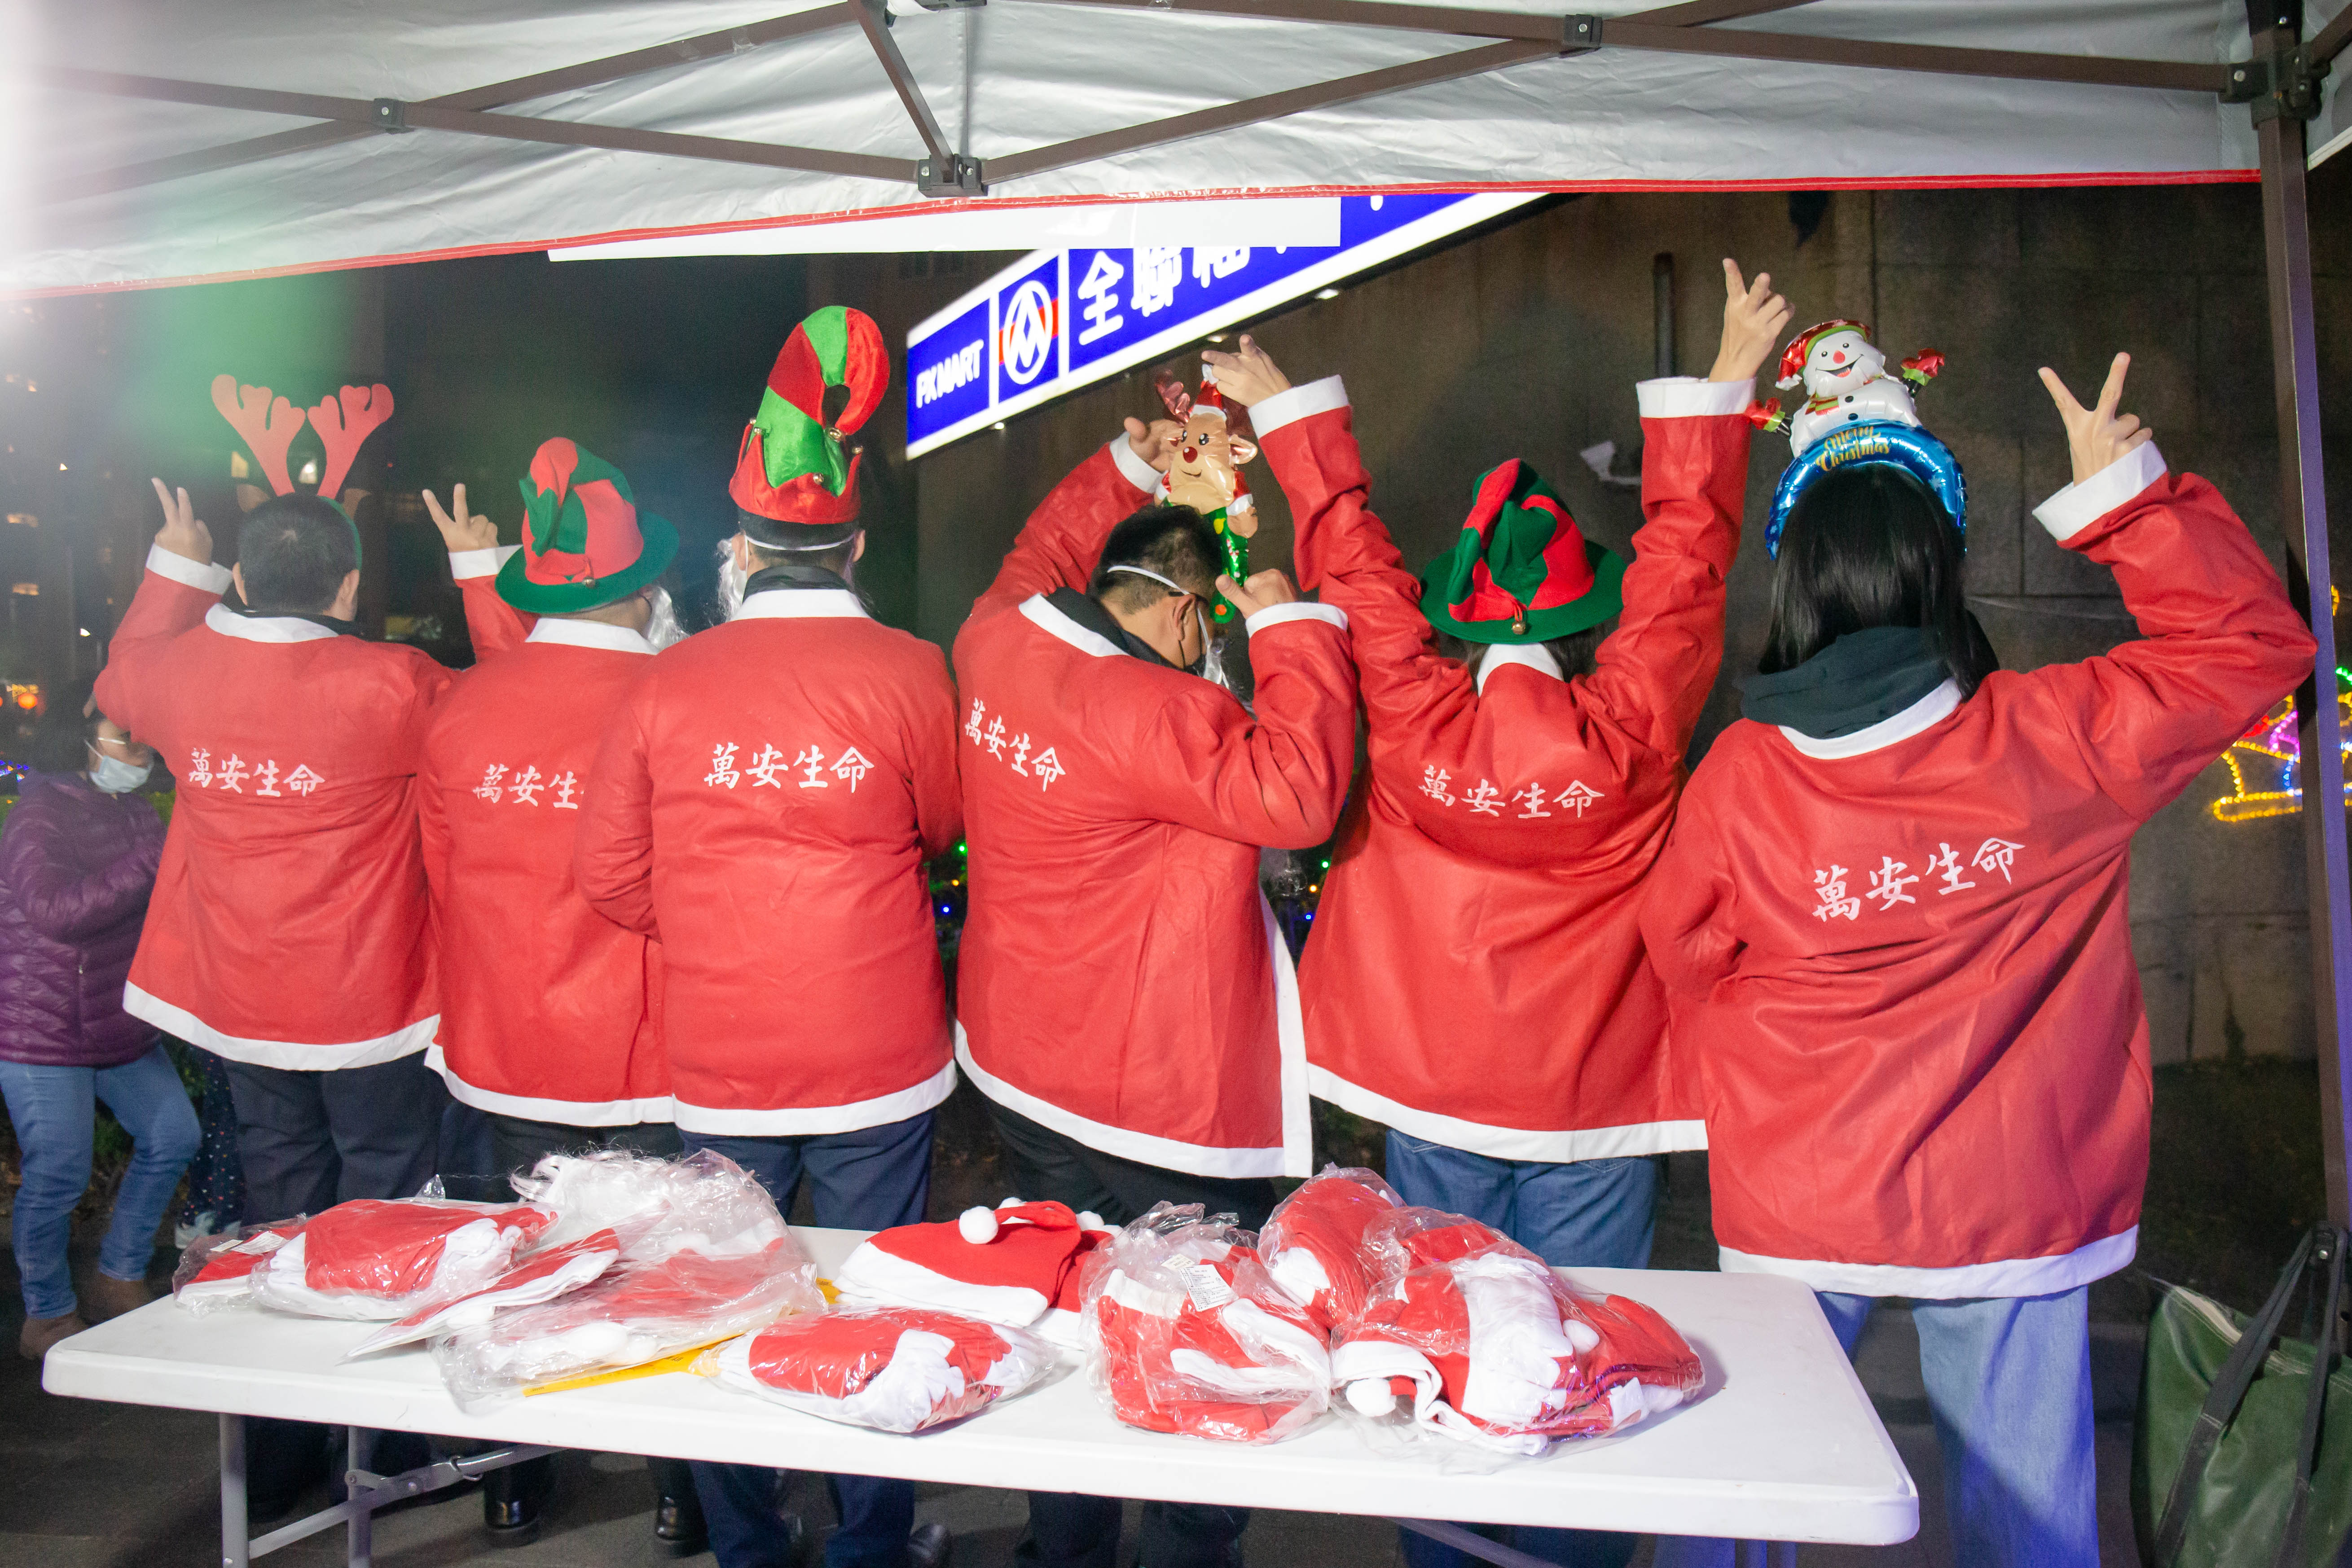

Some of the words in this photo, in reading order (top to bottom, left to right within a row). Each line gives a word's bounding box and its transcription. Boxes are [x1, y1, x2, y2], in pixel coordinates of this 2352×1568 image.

[1816, 438, 1889, 471] Christmas
[1824, 426, 1881, 450] Merry
[703, 742, 875, 794] 萬安生命
[965, 697, 1066, 792] 萬安生命
[189, 747, 325, 797] 萬安生命
[472, 763, 584, 809] 萬安生
[1418, 764, 1605, 818] 萬安生命
[1811, 837, 2026, 922] 萬安生命
